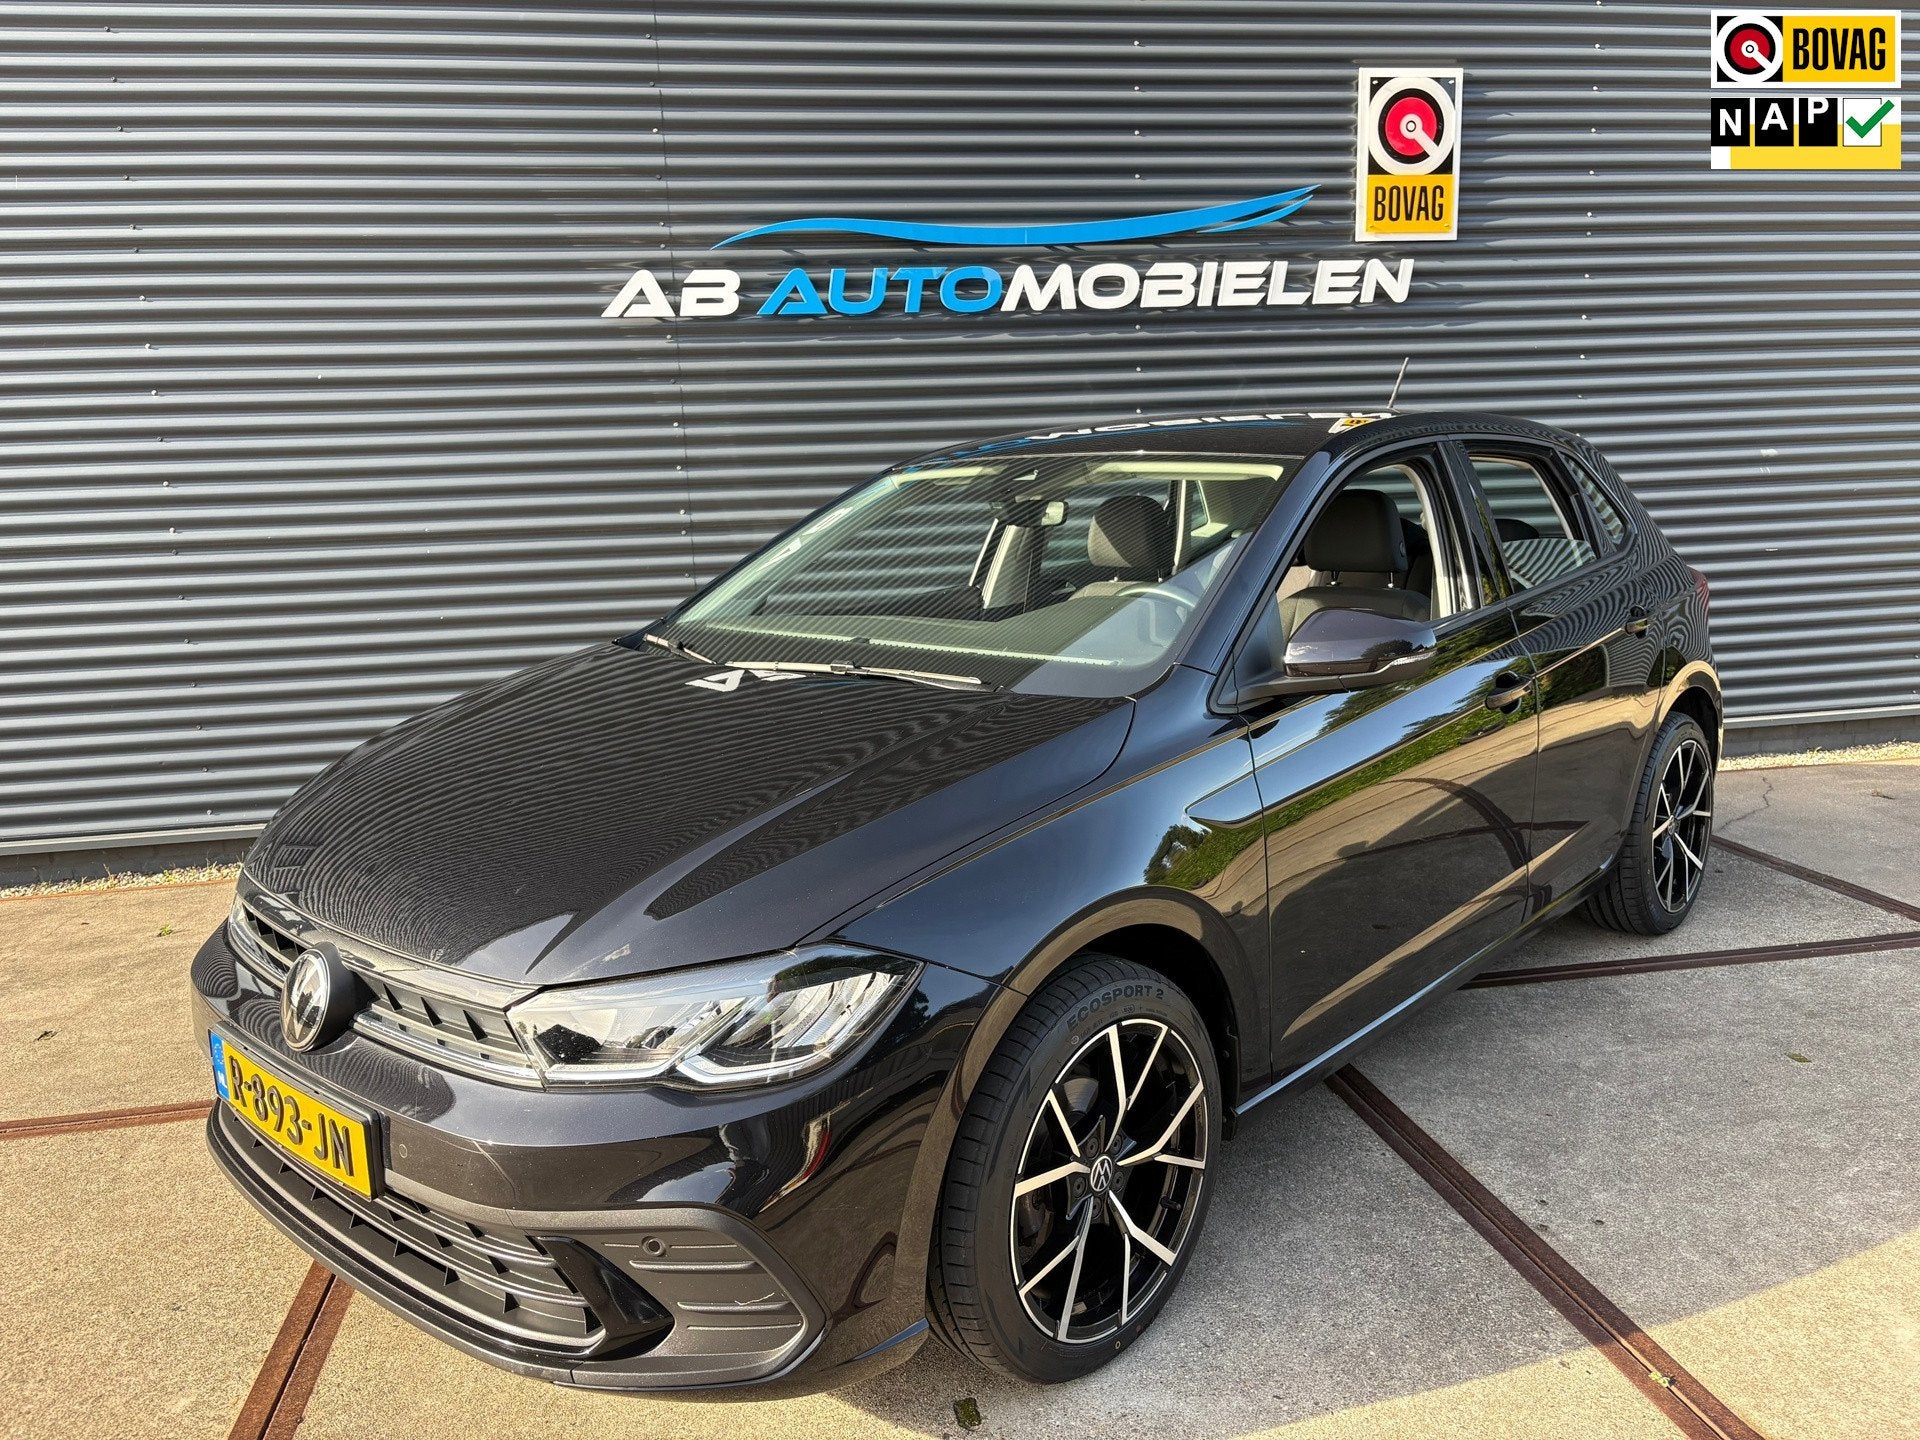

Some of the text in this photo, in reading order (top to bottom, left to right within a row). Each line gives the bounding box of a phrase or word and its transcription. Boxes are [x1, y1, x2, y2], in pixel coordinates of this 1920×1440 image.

[1373, 185, 1445, 222] BOVAG
[600, 258, 1415, 318] AB AUTOMOBIELEN
[1066, 984, 1153, 1032] ECOSPORT
[1155, 988, 1165, 1001] 2
[228, 1055, 355, 1177] R-893-JN
